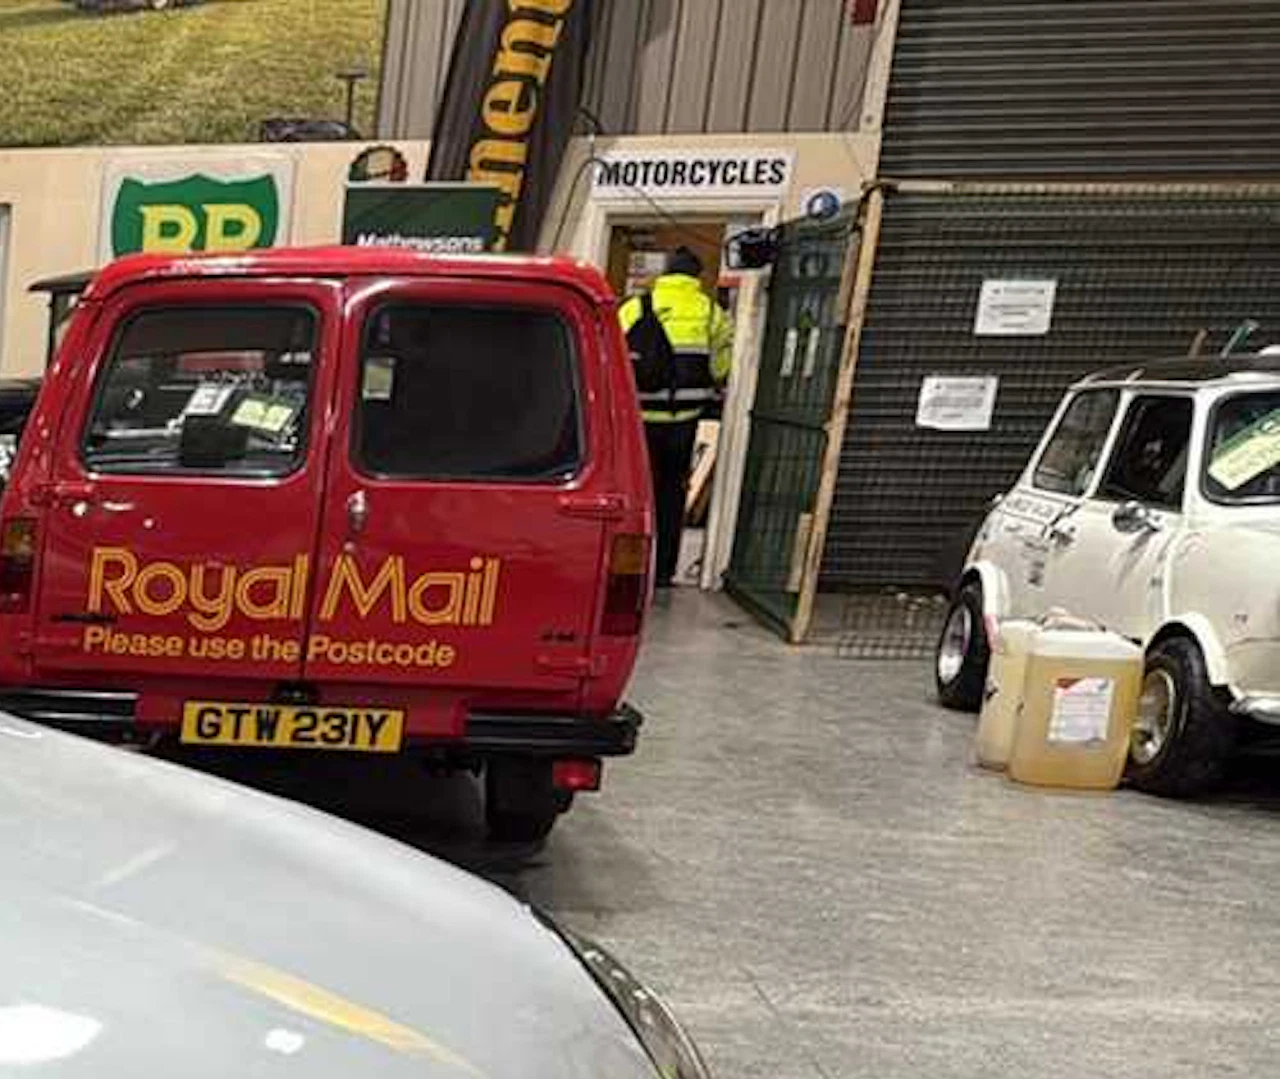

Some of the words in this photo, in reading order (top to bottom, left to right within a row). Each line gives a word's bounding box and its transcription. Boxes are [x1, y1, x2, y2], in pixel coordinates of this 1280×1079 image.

[597, 159, 786, 187] MOTORCYCLES
[87, 546, 310, 631] Royal
[319, 553, 501, 626] Mail
[83, 625, 184, 657] Please
[190, 636, 245, 661] use
[251, 633, 300, 662] the
[306, 633, 456, 667] Postcode
[195, 706, 281, 742] GTW
[290, 711, 390, 746] 231Y
